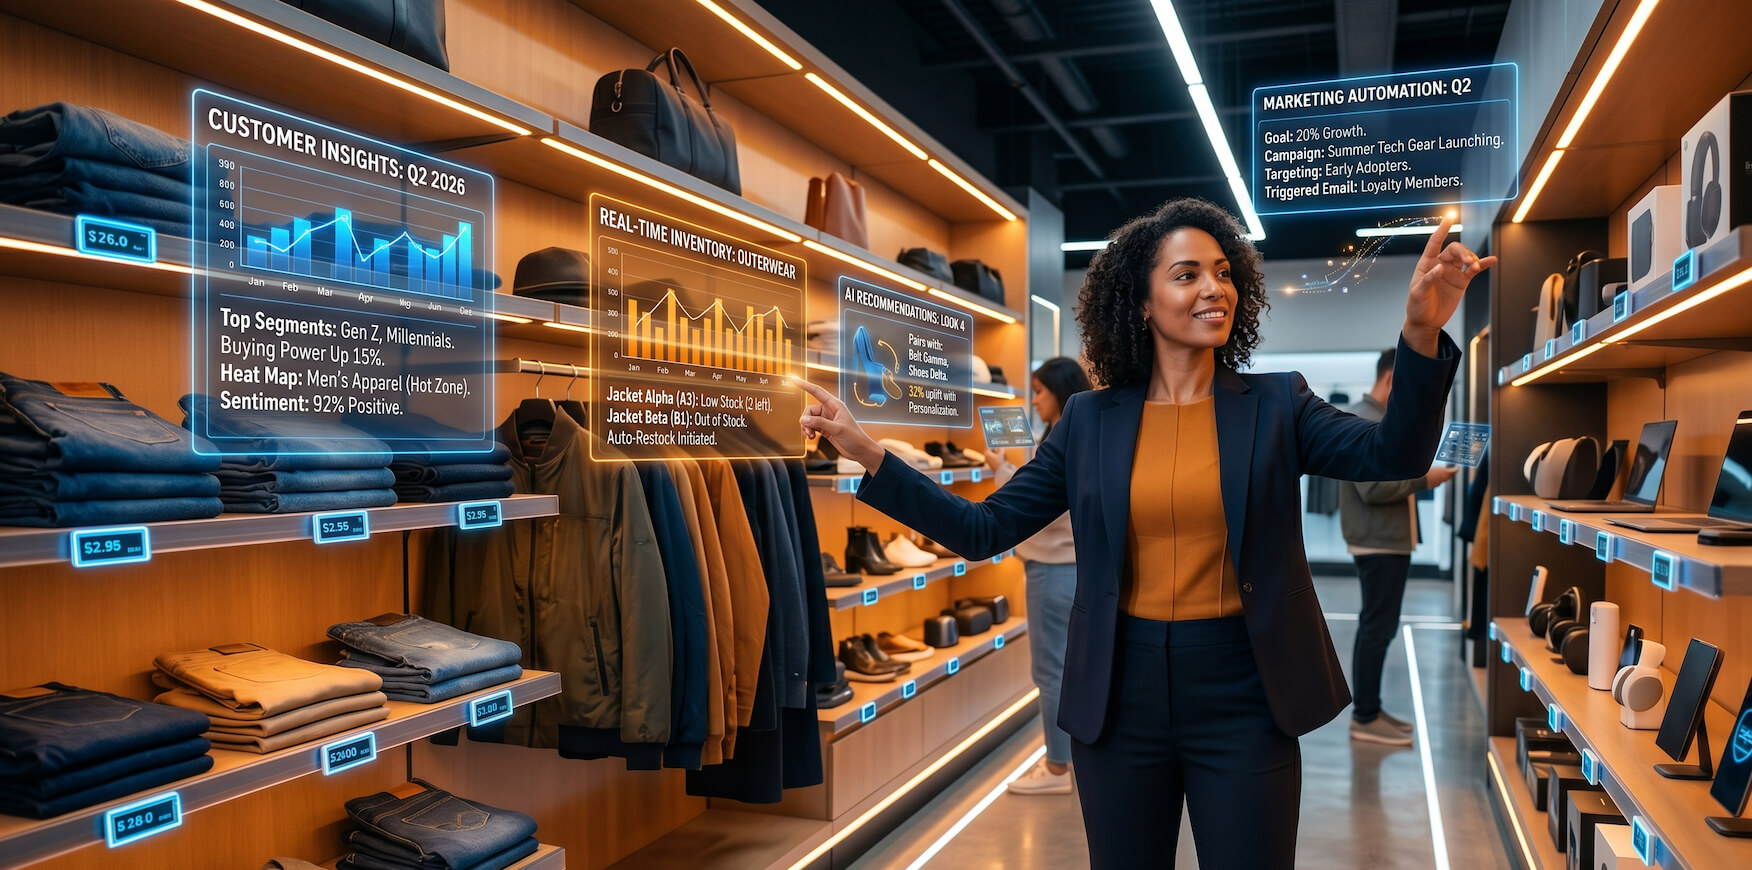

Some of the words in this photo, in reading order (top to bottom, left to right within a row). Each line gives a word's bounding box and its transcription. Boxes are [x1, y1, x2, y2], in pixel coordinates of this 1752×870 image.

[1264, 90, 1344, 110] MARKETING
[1348, 80, 1447, 103] AUTOMATION:
[1452, 77, 1471, 95] Q2
[1265, 130, 1293, 144] Goal:
[1296, 128, 1320, 142] 20%
[1323, 125, 1366, 140] Growth.
[208, 108, 316, 156] CUSTOMER
[322, 139, 403, 179] INSIGHTS:
[408, 164, 427, 186] Q2
[431, 170, 465, 195] 2026
[1265, 148, 1324, 163] Campaign:
[1328, 143, 1375, 158] Summer
[1378, 139, 1404, 154] Tech
[1408, 136, 1436, 151] Gear
[1439, 133, 1504, 150] Launching.
[1265, 167, 1322, 182] Targeting:
[1326, 163, 1354, 178] Early
[1356, 158, 1411, 175] Adopters.
[219, 179, 235, 190] 800
[1265, 182, 1319, 200] Triggered
[1323, 181, 1357, 195] Email:
[1361, 177, 1401, 193] Loyalty
[1405, 174, 1463, 190] Members.
[219, 200, 234, 210] 600
[219, 220, 234, 229] 400
[220, 239, 235, 249] 200
[600, 207, 667, 243] REAL-TIME
[671, 228, 735, 262] INVENTORY:
[738, 249, 796, 279] OUTERWEAR
[249, 277, 265, 287] Jan
[283, 282, 298, 292] Feb
[318, 287, 333, 297] Mar
[359, 293, 373, 303] Apr
[428, 302, 441, 311] Jun
[845, 287, 854, 301] AI
[857, 290, 939, 324] RECOMMENDATIONS:
[941, 315, 958, 330] LOOK
[960, 321, 965, 331] 4
[220, 308, 250, 332] Top
[255, 312, 336, 337] Segments:
[341, 321, 367, 340] Gen
[371, 325, 382, 344] Z,
[387, 327, 455, 348] Millennials.
[221, 336, 275, 361] Buying
[280, 341, 326, 361] Power
[331, 345, 348, 365] Up
[353, 348, 385, 366] 15%.
[909, 333, 925, 346] Pairs
[927, 338, 943, 350] with:
[909, 349, 922, 362] Belt
[924, 352, 948, 368] Gamma,
[221, 363, 260, 383] Heat
[265, 367, 302, 389] Map:
[352, 373, 401, 393] Apparel
[406, 374, 432, 395] (Hot
[435, 378, 470, 398] Zone).
[736, 375, 746, 383] May
[909, 365, 929, 378] Shoes
[930, 368, 948, 381] Delta.
[220, 391, 309, 412] Sentiment:
[314, 396, 344, 413] 92%
[349, 398, 403, 415] Positive.
[607, 386, 642, 403] Jacket
[645, 390, 673, 407] Alpha
[677, 391, 698, 408] (A3):
[701, 394, 718, 407] Low
[721, 395, 743, 409] Stock
[746, 396, 752, 412] (2
[755, 397, 772, 414] left).
[909, 385, 924, 398] 32%
[926, 388, 942, 402] uplift
[943, 391, 956, 401] with
[607, 408, 642, 423] Jacket
[645, 411, 667, 424] Beta
[671, 411, 692, 428] (B1):
[695, 412, 710, 426] Out
[712, 413, 721, 426] of
[723, 414, 747, 427] Stock.
[909, 402, 958, 416] Personalization.
[607, 430, 675, 445] Auto-Restock
[678, 431, 717, 445] Initiated.
[84, 540, 121, 554] $2.95
